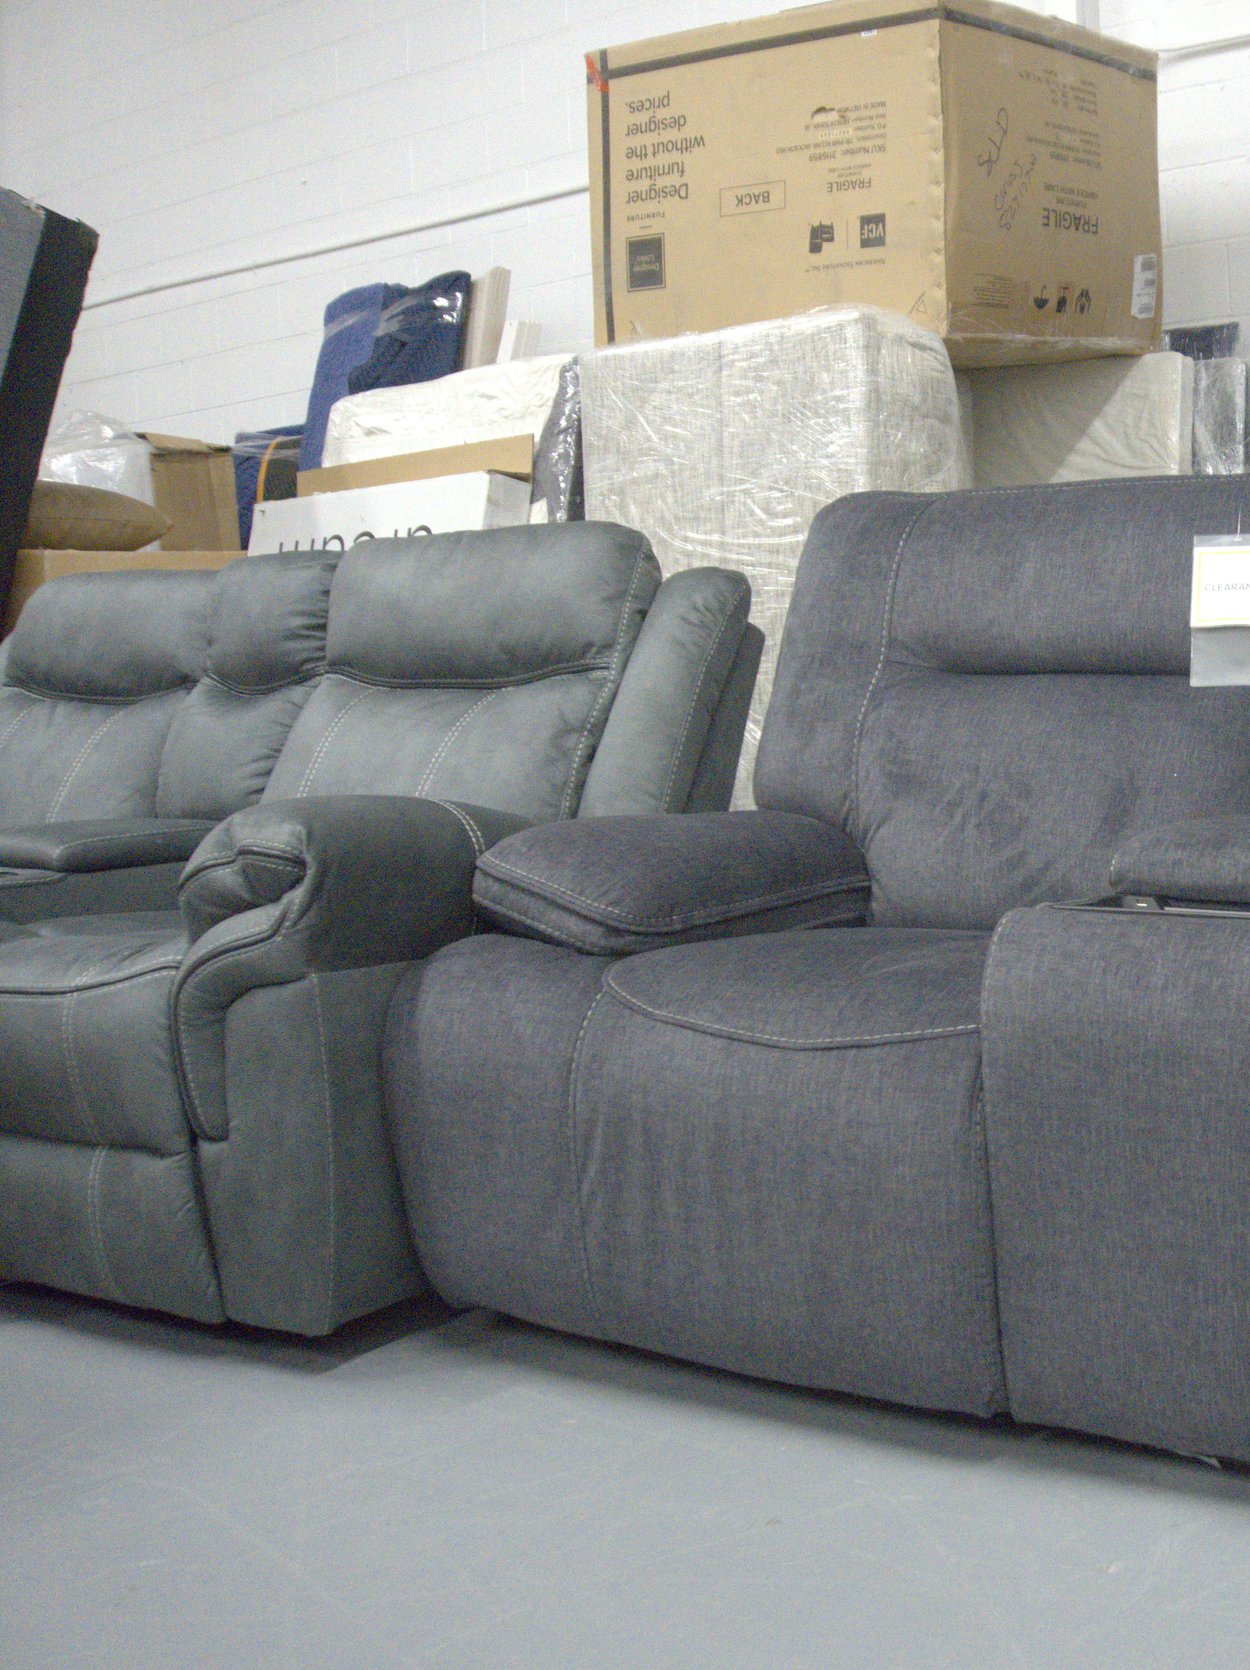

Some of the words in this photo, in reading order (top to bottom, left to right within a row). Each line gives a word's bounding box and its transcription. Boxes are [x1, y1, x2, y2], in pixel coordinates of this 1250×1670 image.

[625, 91, 670, 114] prices.
[625, 115, 686, 138] designer
[626, 145, 647, 160] the
[651, 135, 706, 156] without
[840, 145, 870, 156] Number:
[871, 143, 886, 153] SKU
[626, 161, 685, 182] furniture
[626, 183, 689, 204] Designer
[827, 177, 871, 193] FRAGILE
[735, 190, 770, 208] BACK
[860, 222, 885, 239] VCF
[1042, 208, 1098, 235] FRAGILE
